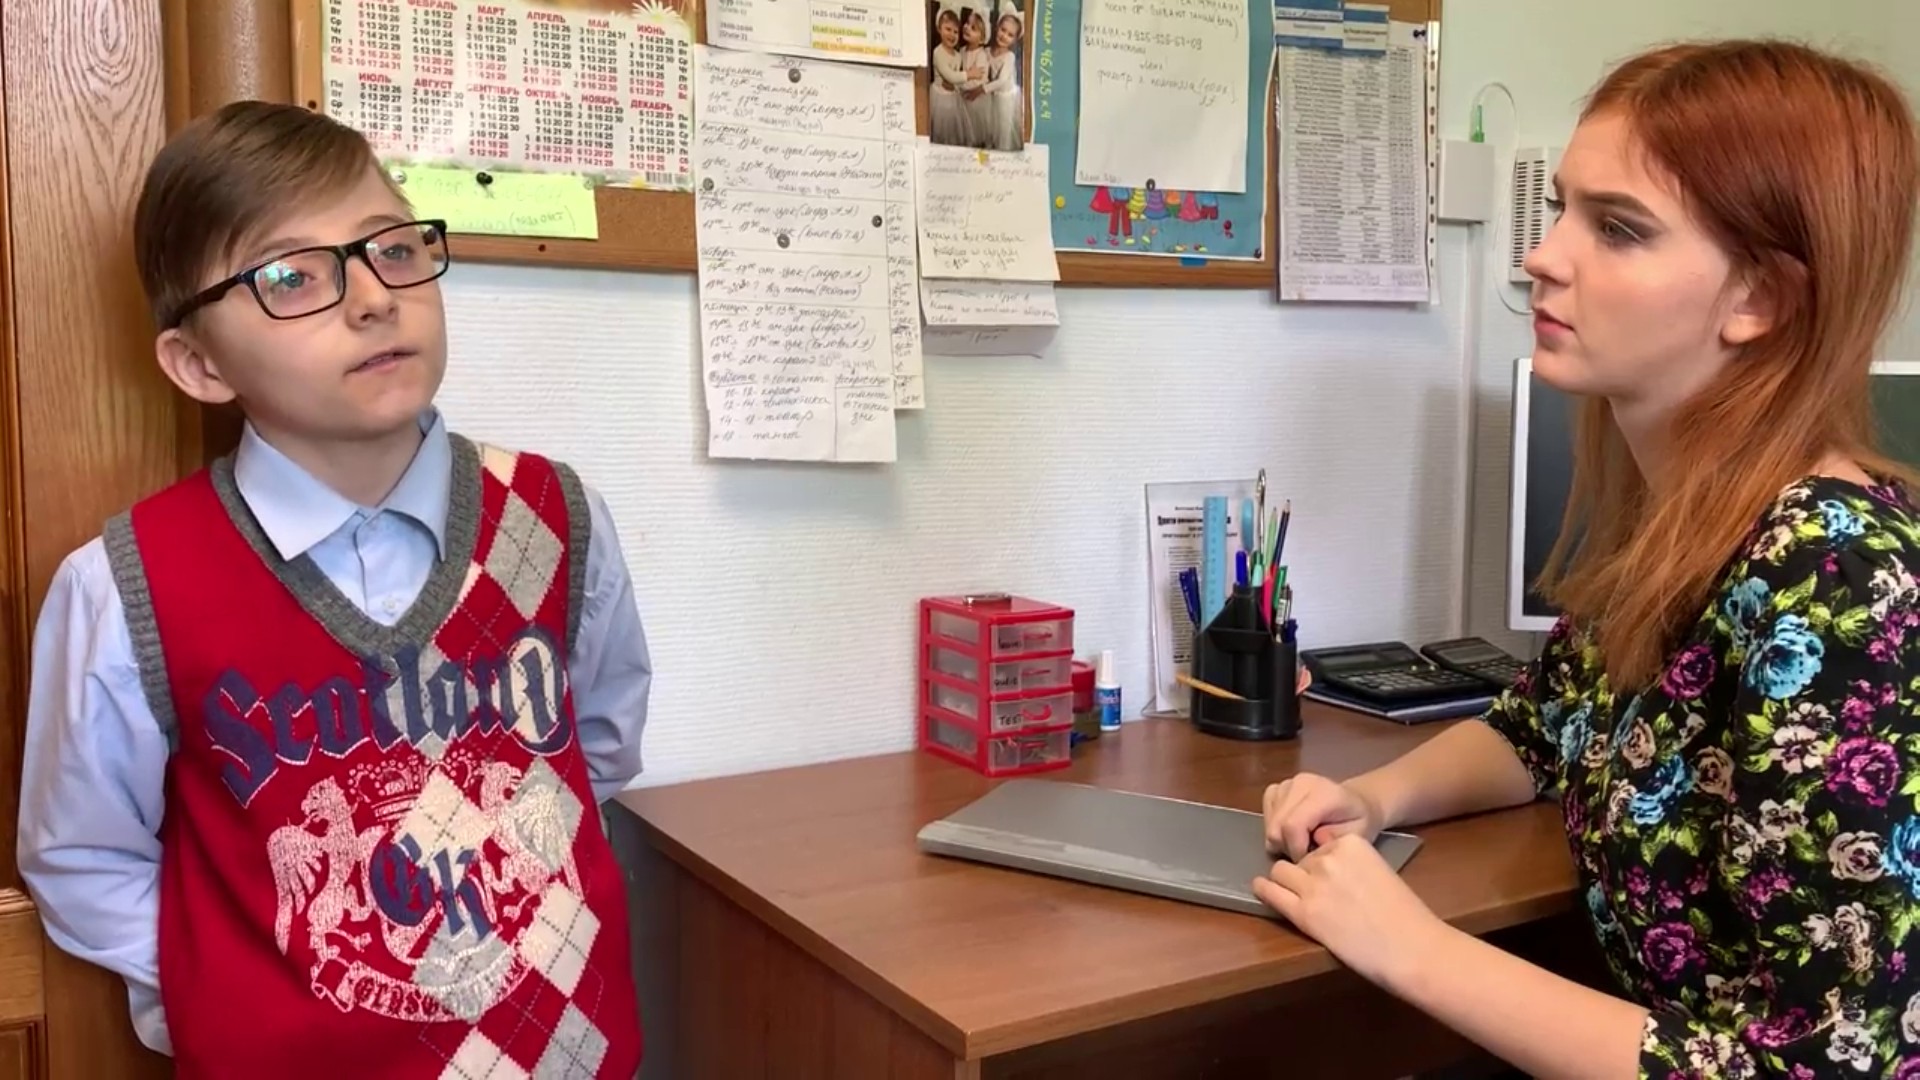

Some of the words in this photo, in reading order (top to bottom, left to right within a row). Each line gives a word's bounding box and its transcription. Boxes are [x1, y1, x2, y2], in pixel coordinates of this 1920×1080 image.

[477, 4, 506, 16] МАРТ
[526, 11, 567, 23] АПРЕЛЬ
[587, 19, 610, 29] МАЙ
[636, 23, 666, 36] ИЮНЬ
[359, 72, 391, 83] ИЮЛЬ
[414, 78, 453, 89] АВГУСТ
[581, 94, 619, 106] НОЯБРЬ
[630, 99, 673, 111] ДЕКАБРЬ
